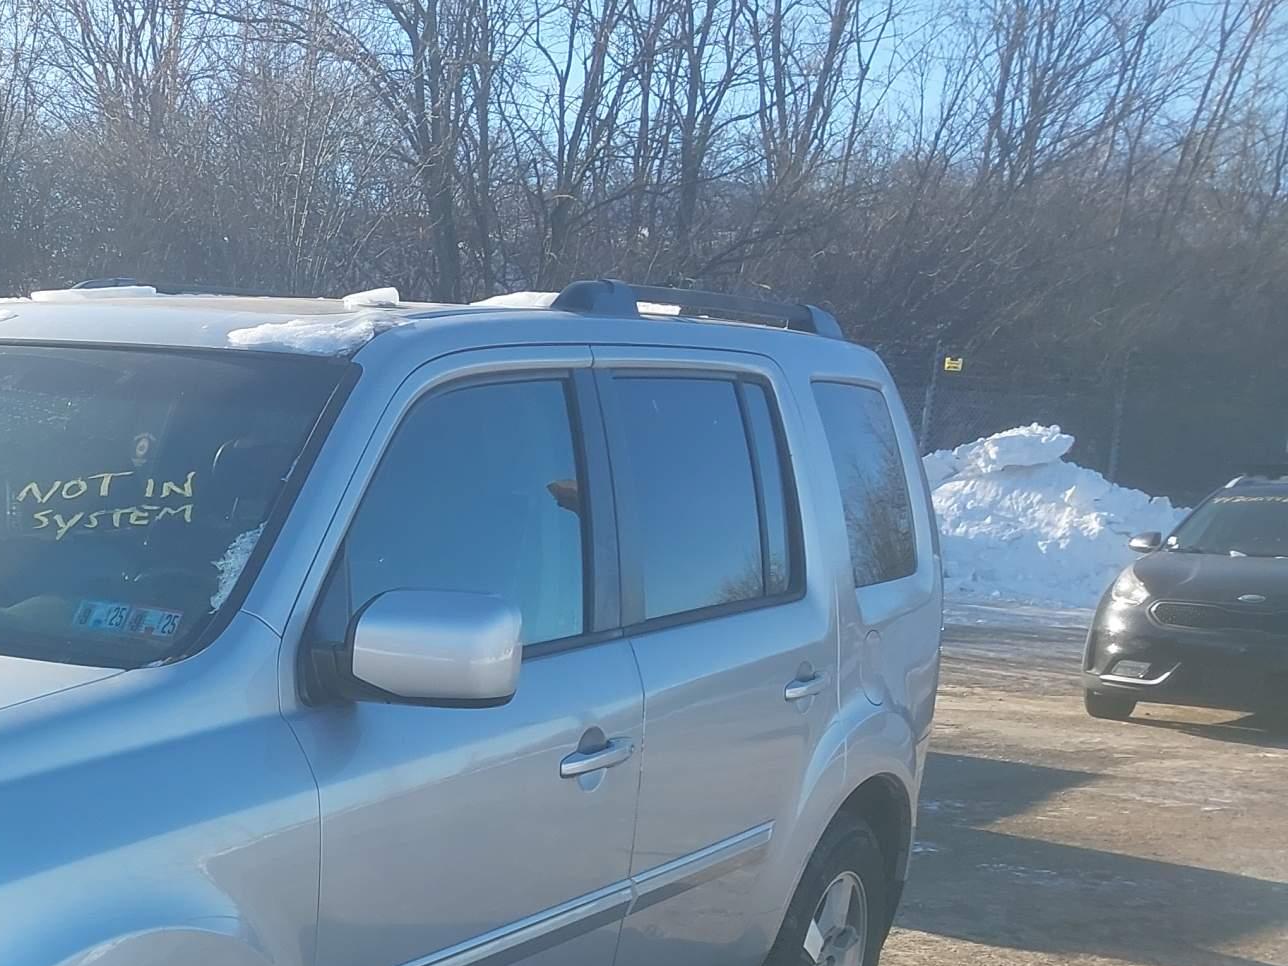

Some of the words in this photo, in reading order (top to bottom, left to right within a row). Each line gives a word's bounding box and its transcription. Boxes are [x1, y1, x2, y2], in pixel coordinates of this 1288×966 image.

[16, 471, 134, 503] NOT
[144, 471, 197, 498] IN
[107, 606, 127, 627] 25
[160, 613, 180, 635] 25
